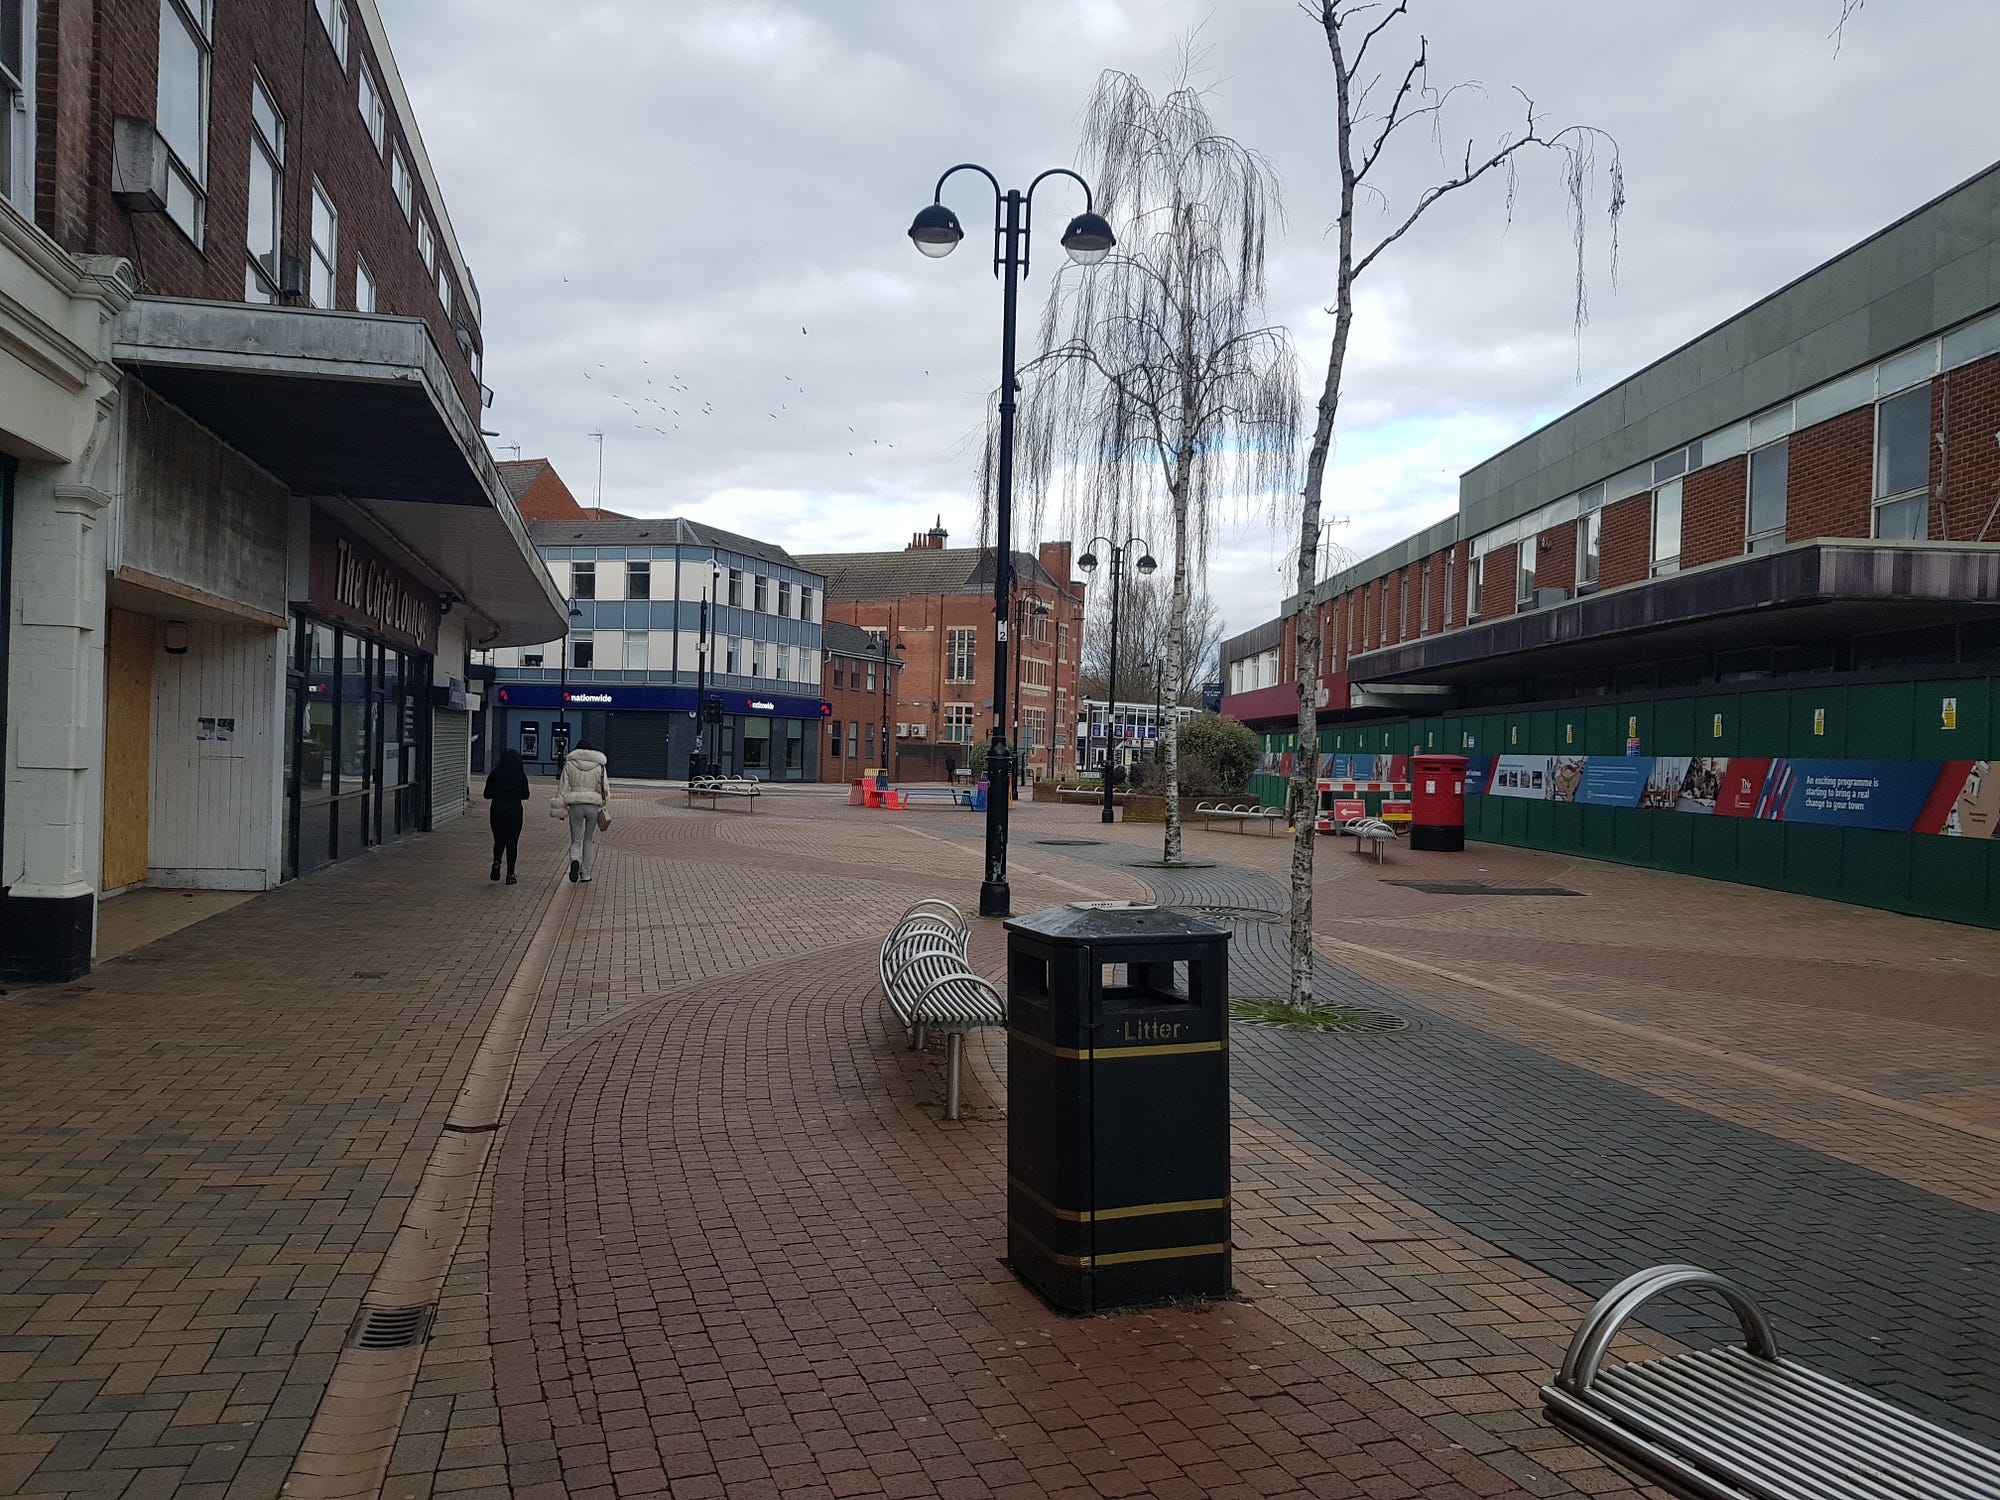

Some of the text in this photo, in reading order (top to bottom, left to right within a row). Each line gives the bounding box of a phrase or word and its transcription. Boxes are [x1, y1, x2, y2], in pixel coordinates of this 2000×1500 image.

[336, 538, 427, 647] The Cafe Lounge
[999, 631, 1006, 641] 2
[571, 693, 613, 703] nationwide
[1806, 775, 1879, 788] An exciting programme is
[1806, 787, 1827, 798] starting
[1828, 788, 1834, 797] to
[1835, 788, 1851, 800] bring
[1858, 789, 1870, 799] real
[1805, 798, 1864, 811] change to your town
[1124, 1018, 1181, 1040] Litter
